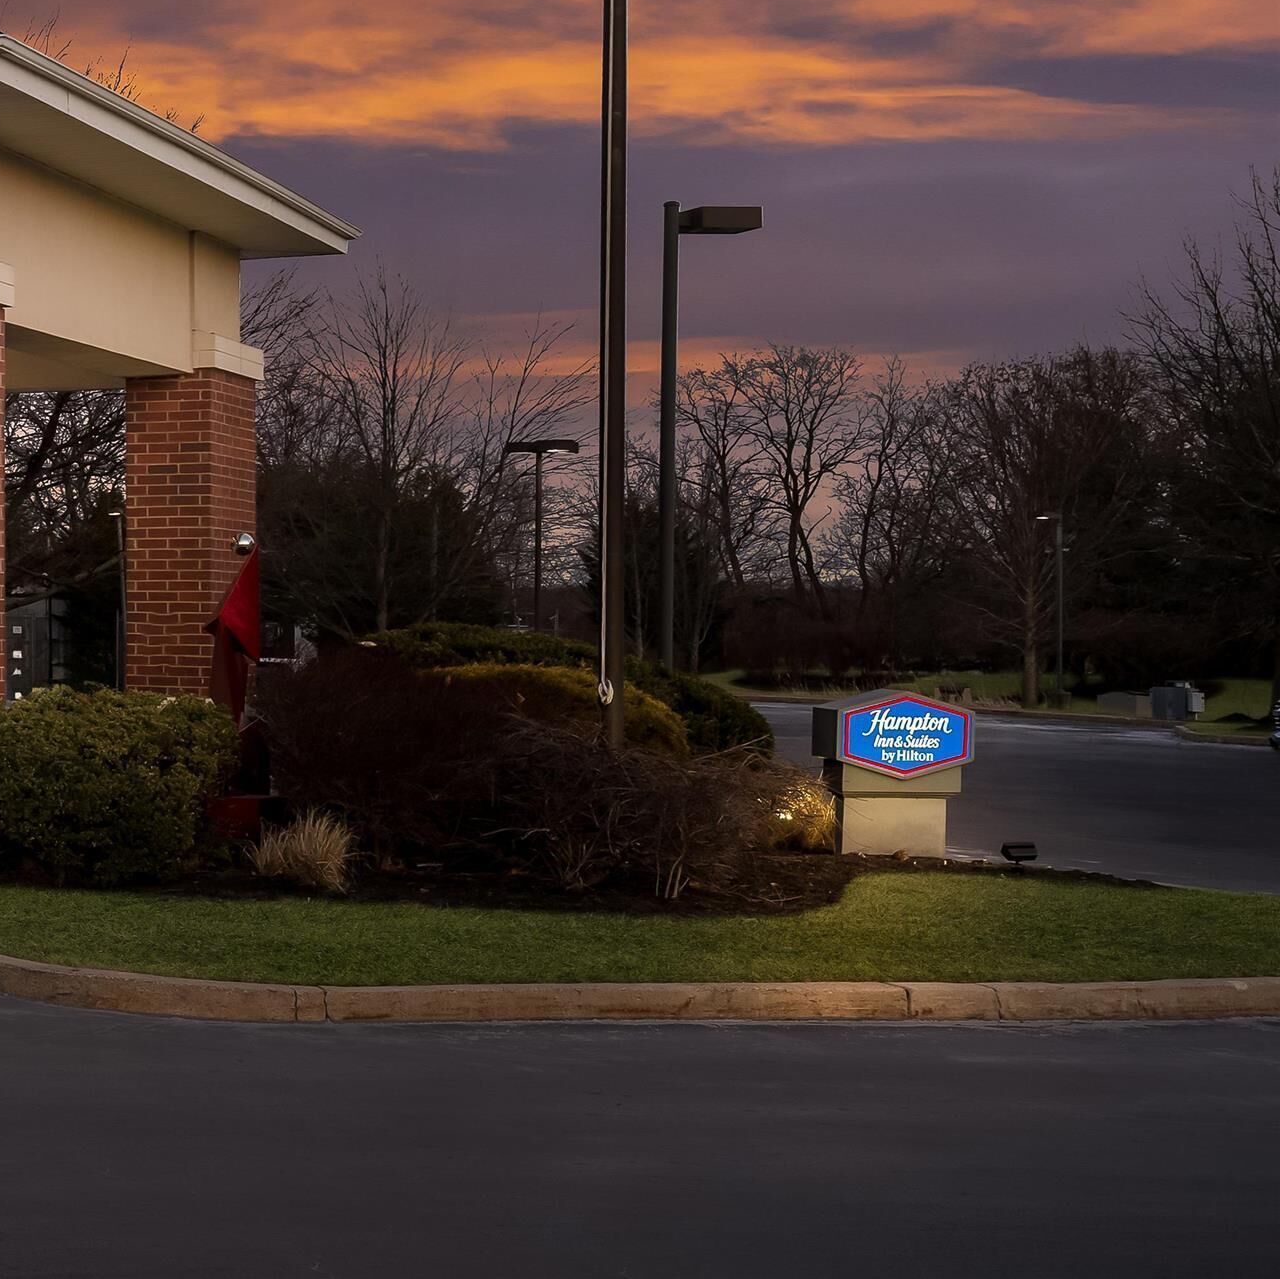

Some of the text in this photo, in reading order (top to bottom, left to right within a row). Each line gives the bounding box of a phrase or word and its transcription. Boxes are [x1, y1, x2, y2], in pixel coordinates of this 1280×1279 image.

[862, 708, 953, 735] Hampton
[881, 750, 934, 763] by Hilton
